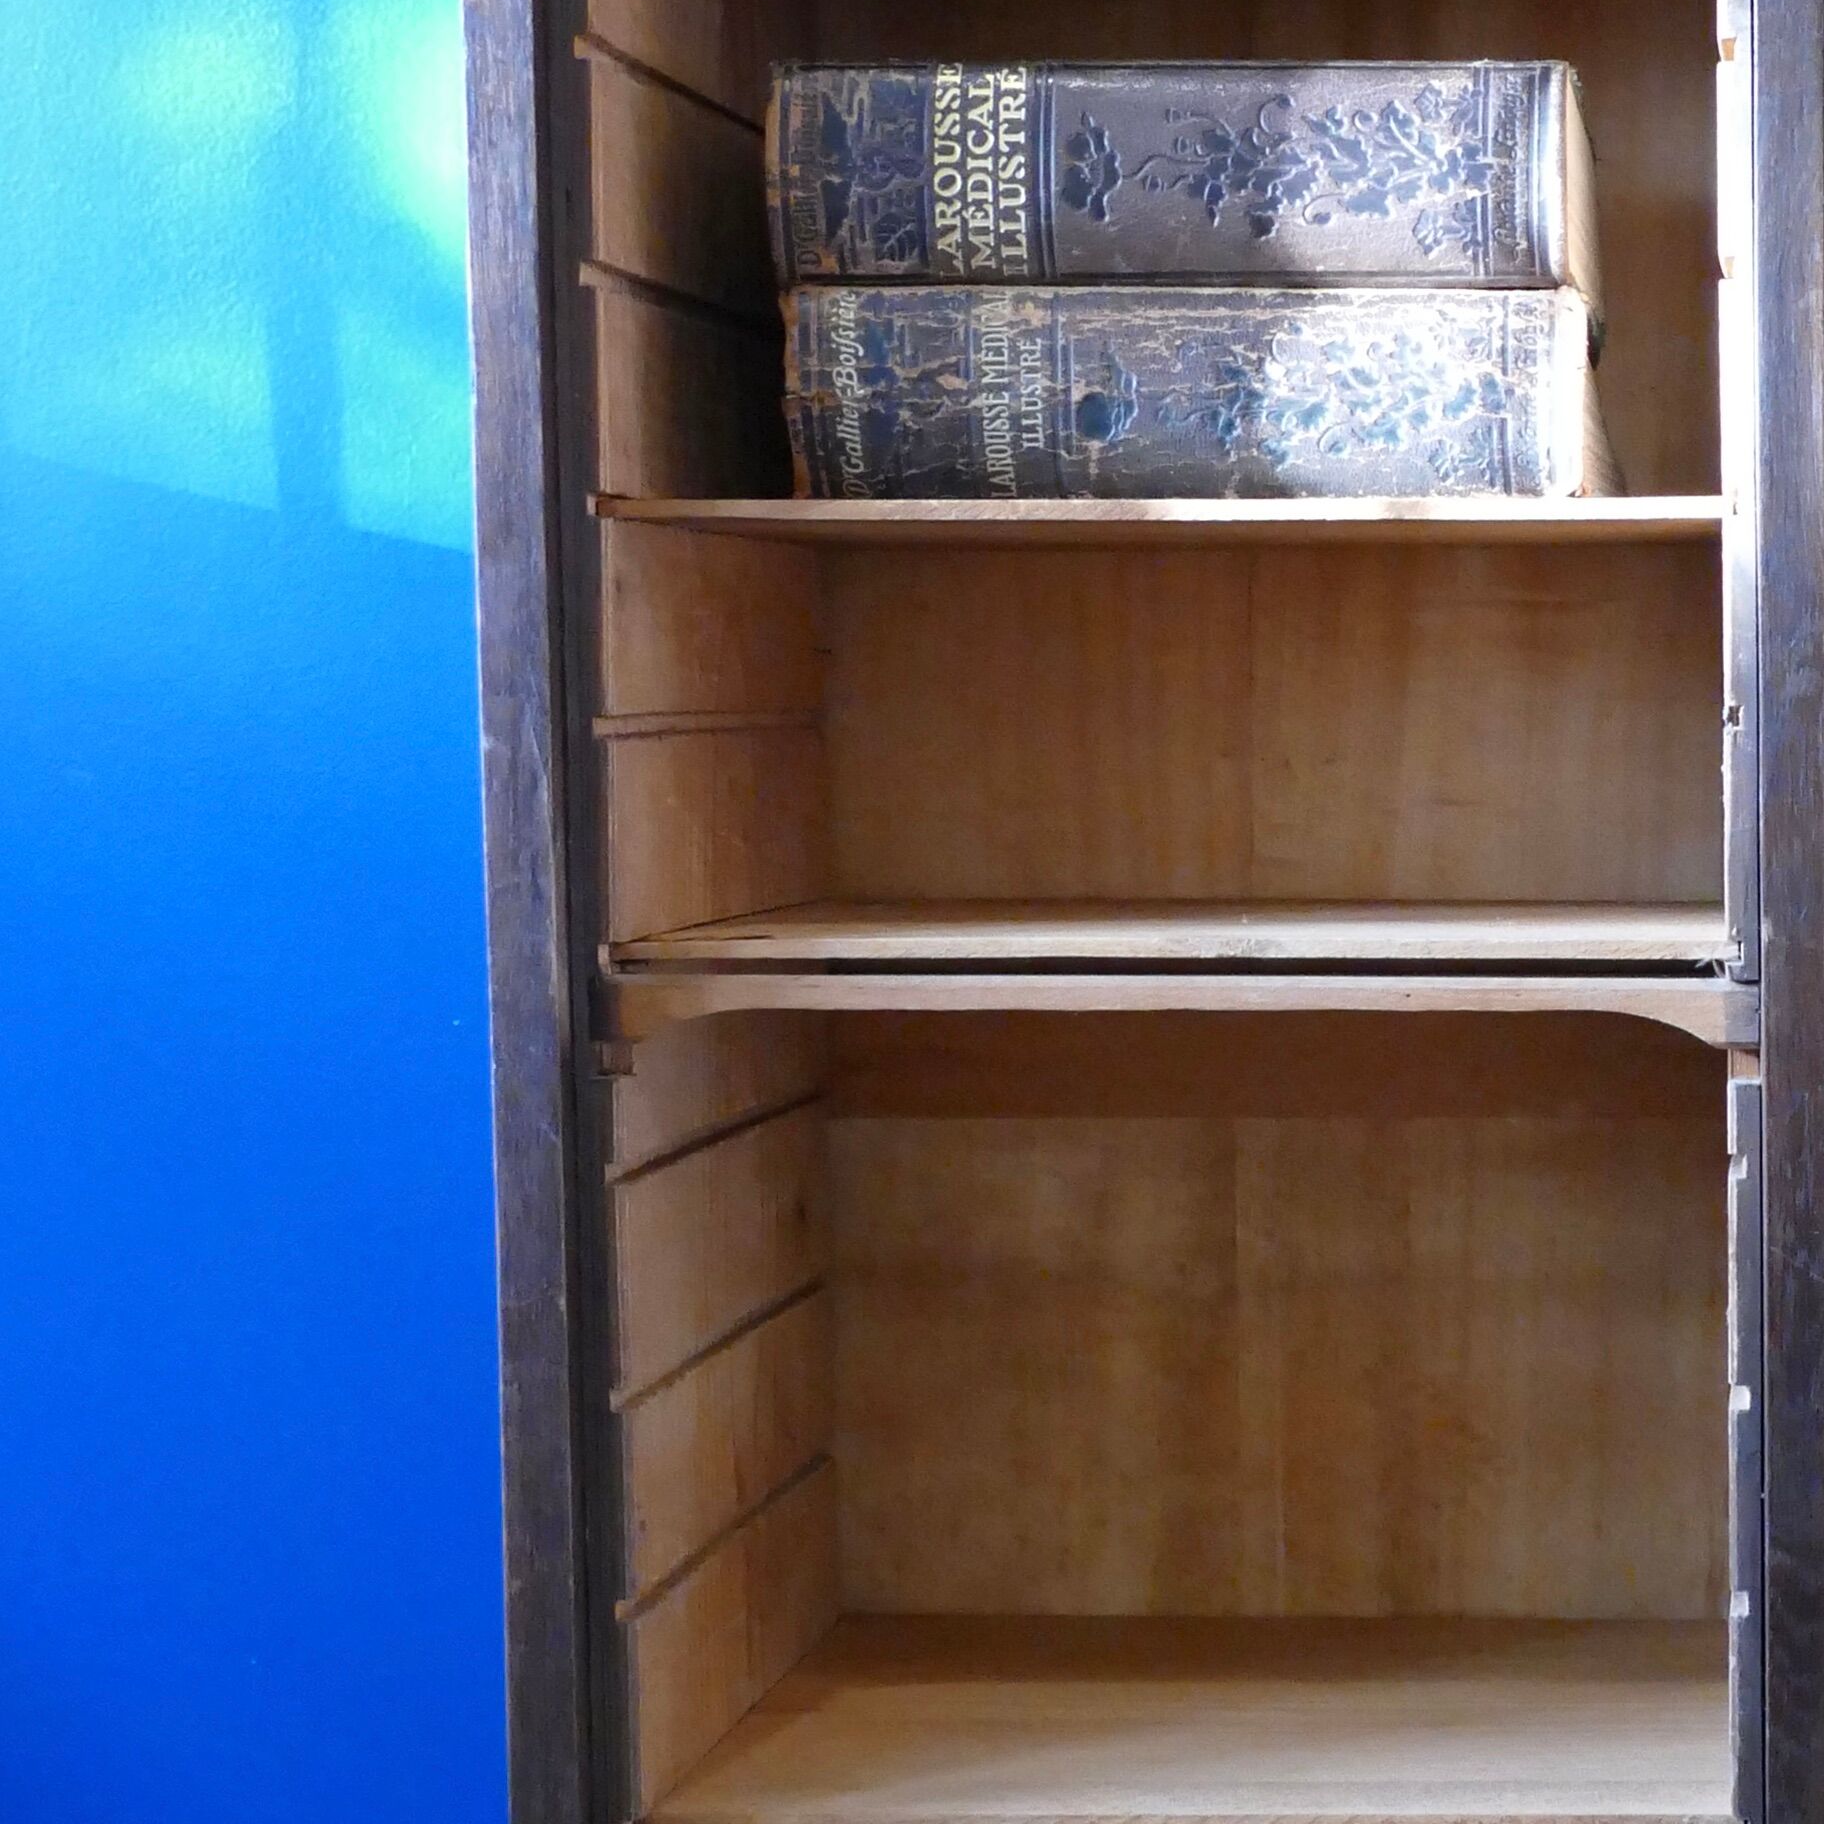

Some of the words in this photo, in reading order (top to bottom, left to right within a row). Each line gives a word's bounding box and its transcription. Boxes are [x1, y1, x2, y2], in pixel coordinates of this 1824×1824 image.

[934, 62, 964, 277] LAROUSSE
[962, 73, 996, 270] MÉDICAL
[995, 67, 1029, 277] ILLUSTRÉ
[982, 391, 1018, 498] LAROUSSE
[1016, 337, 1045, 449] ILLUSTRÉ
